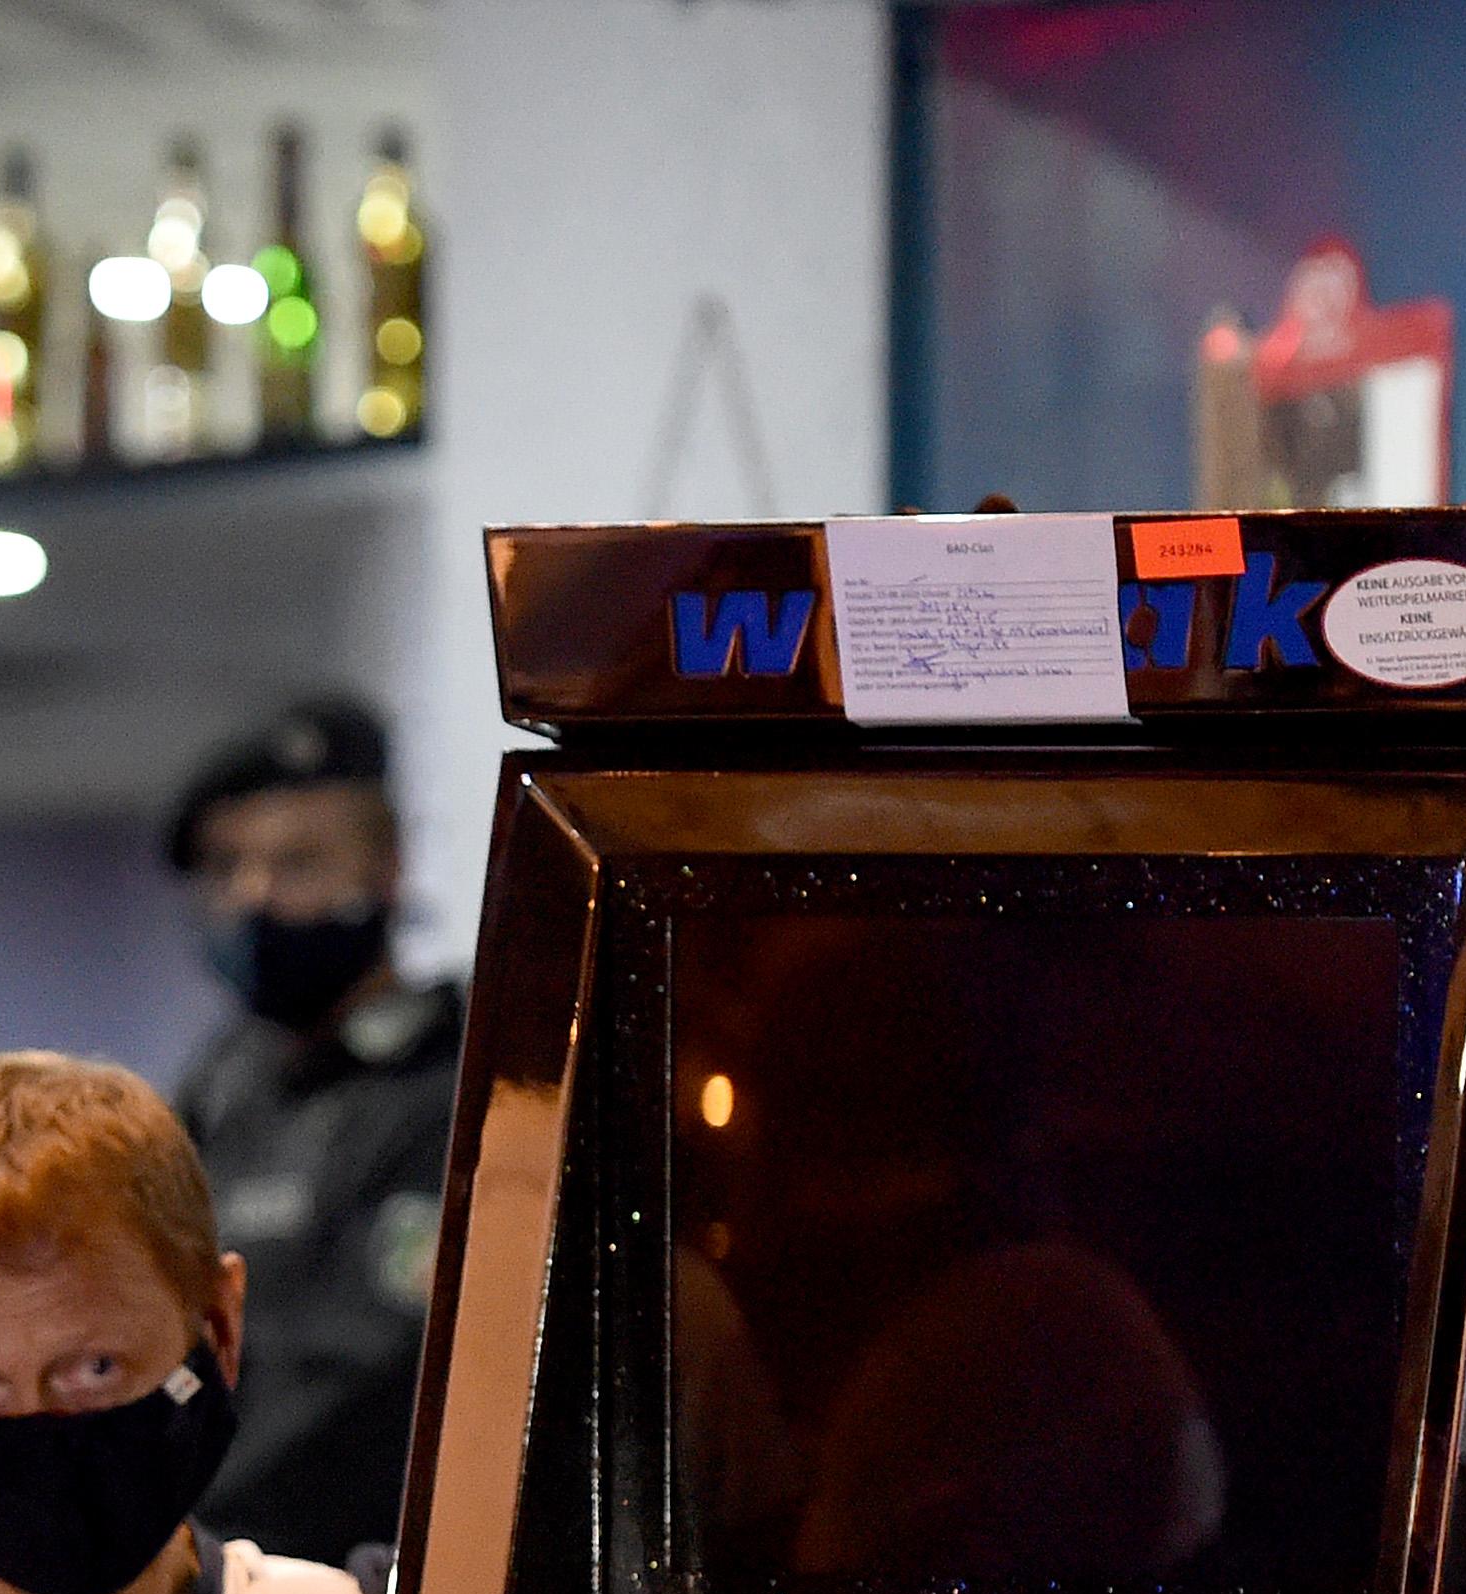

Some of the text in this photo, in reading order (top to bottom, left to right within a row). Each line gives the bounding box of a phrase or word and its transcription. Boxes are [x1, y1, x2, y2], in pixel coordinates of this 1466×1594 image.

[1356, 578, 1389, 590] KEINE
[1392, 575, 1443, 588] AUSGABE
[1400, 611, 1433, 624] KEINE
